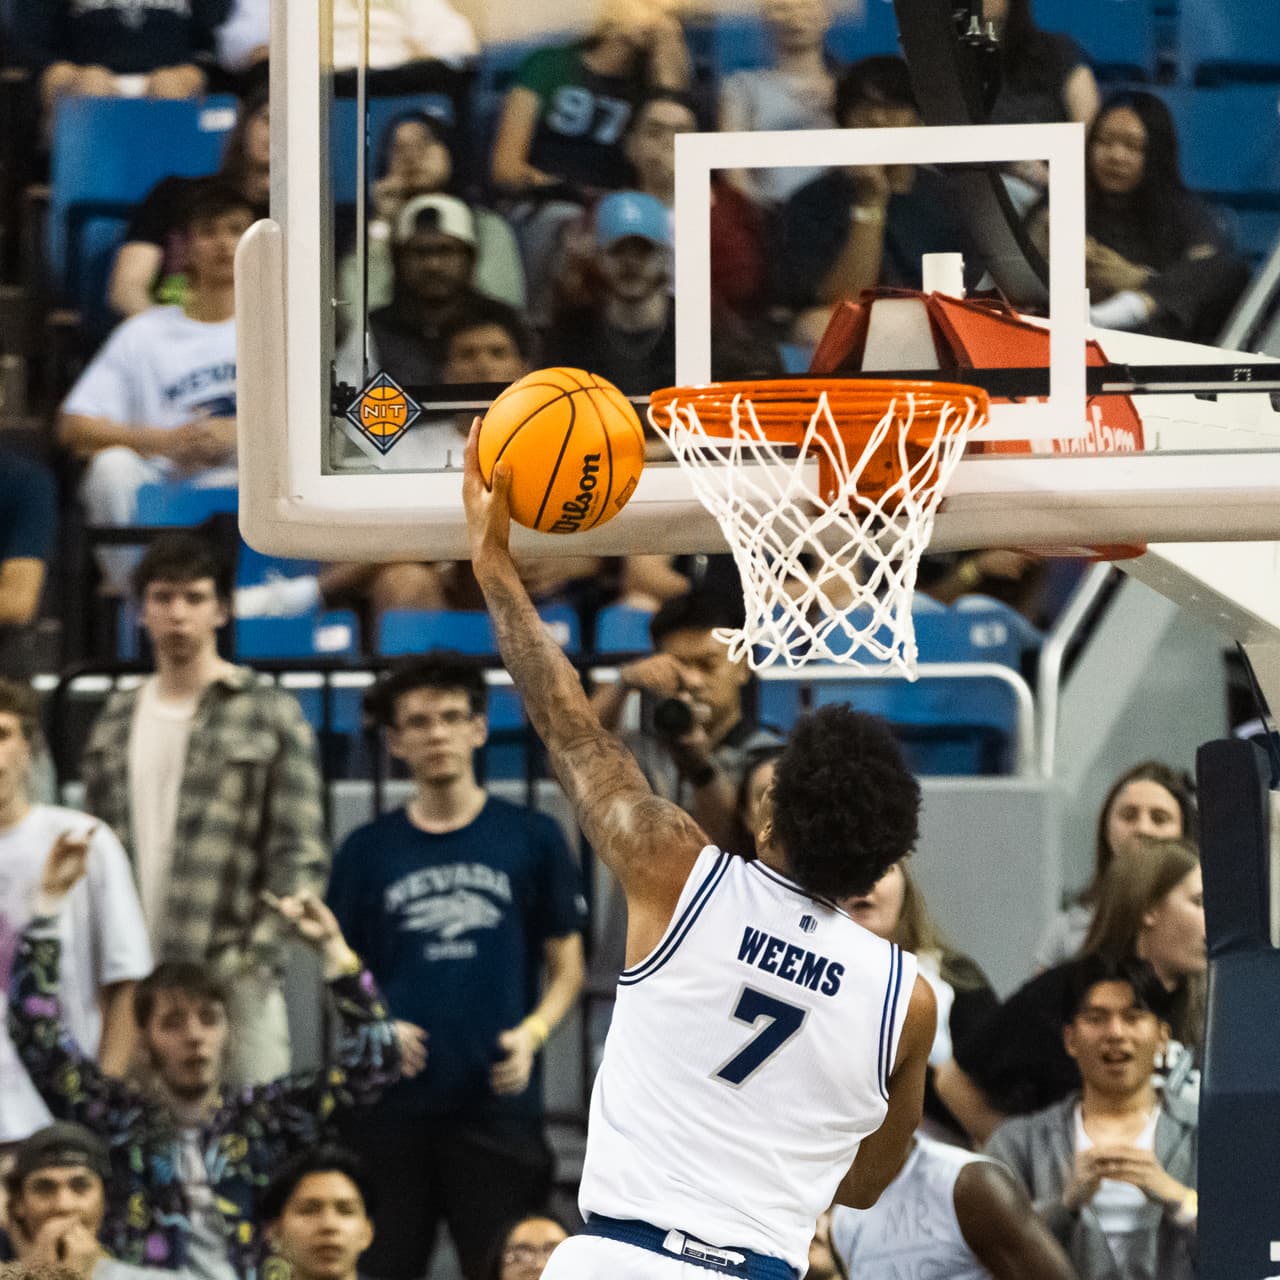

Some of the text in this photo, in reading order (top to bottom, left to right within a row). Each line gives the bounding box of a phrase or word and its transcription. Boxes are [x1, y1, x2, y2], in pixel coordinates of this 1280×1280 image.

[546, 86, 632, 145] 97
[363, 404, 405, 419] NIT
[547, 452, 601, 534] Wilson
[385, 863, 513, 912] NEVADA
[737, 925, 846, 997] WEEMS
[708, 982, 812, 1090] 7
